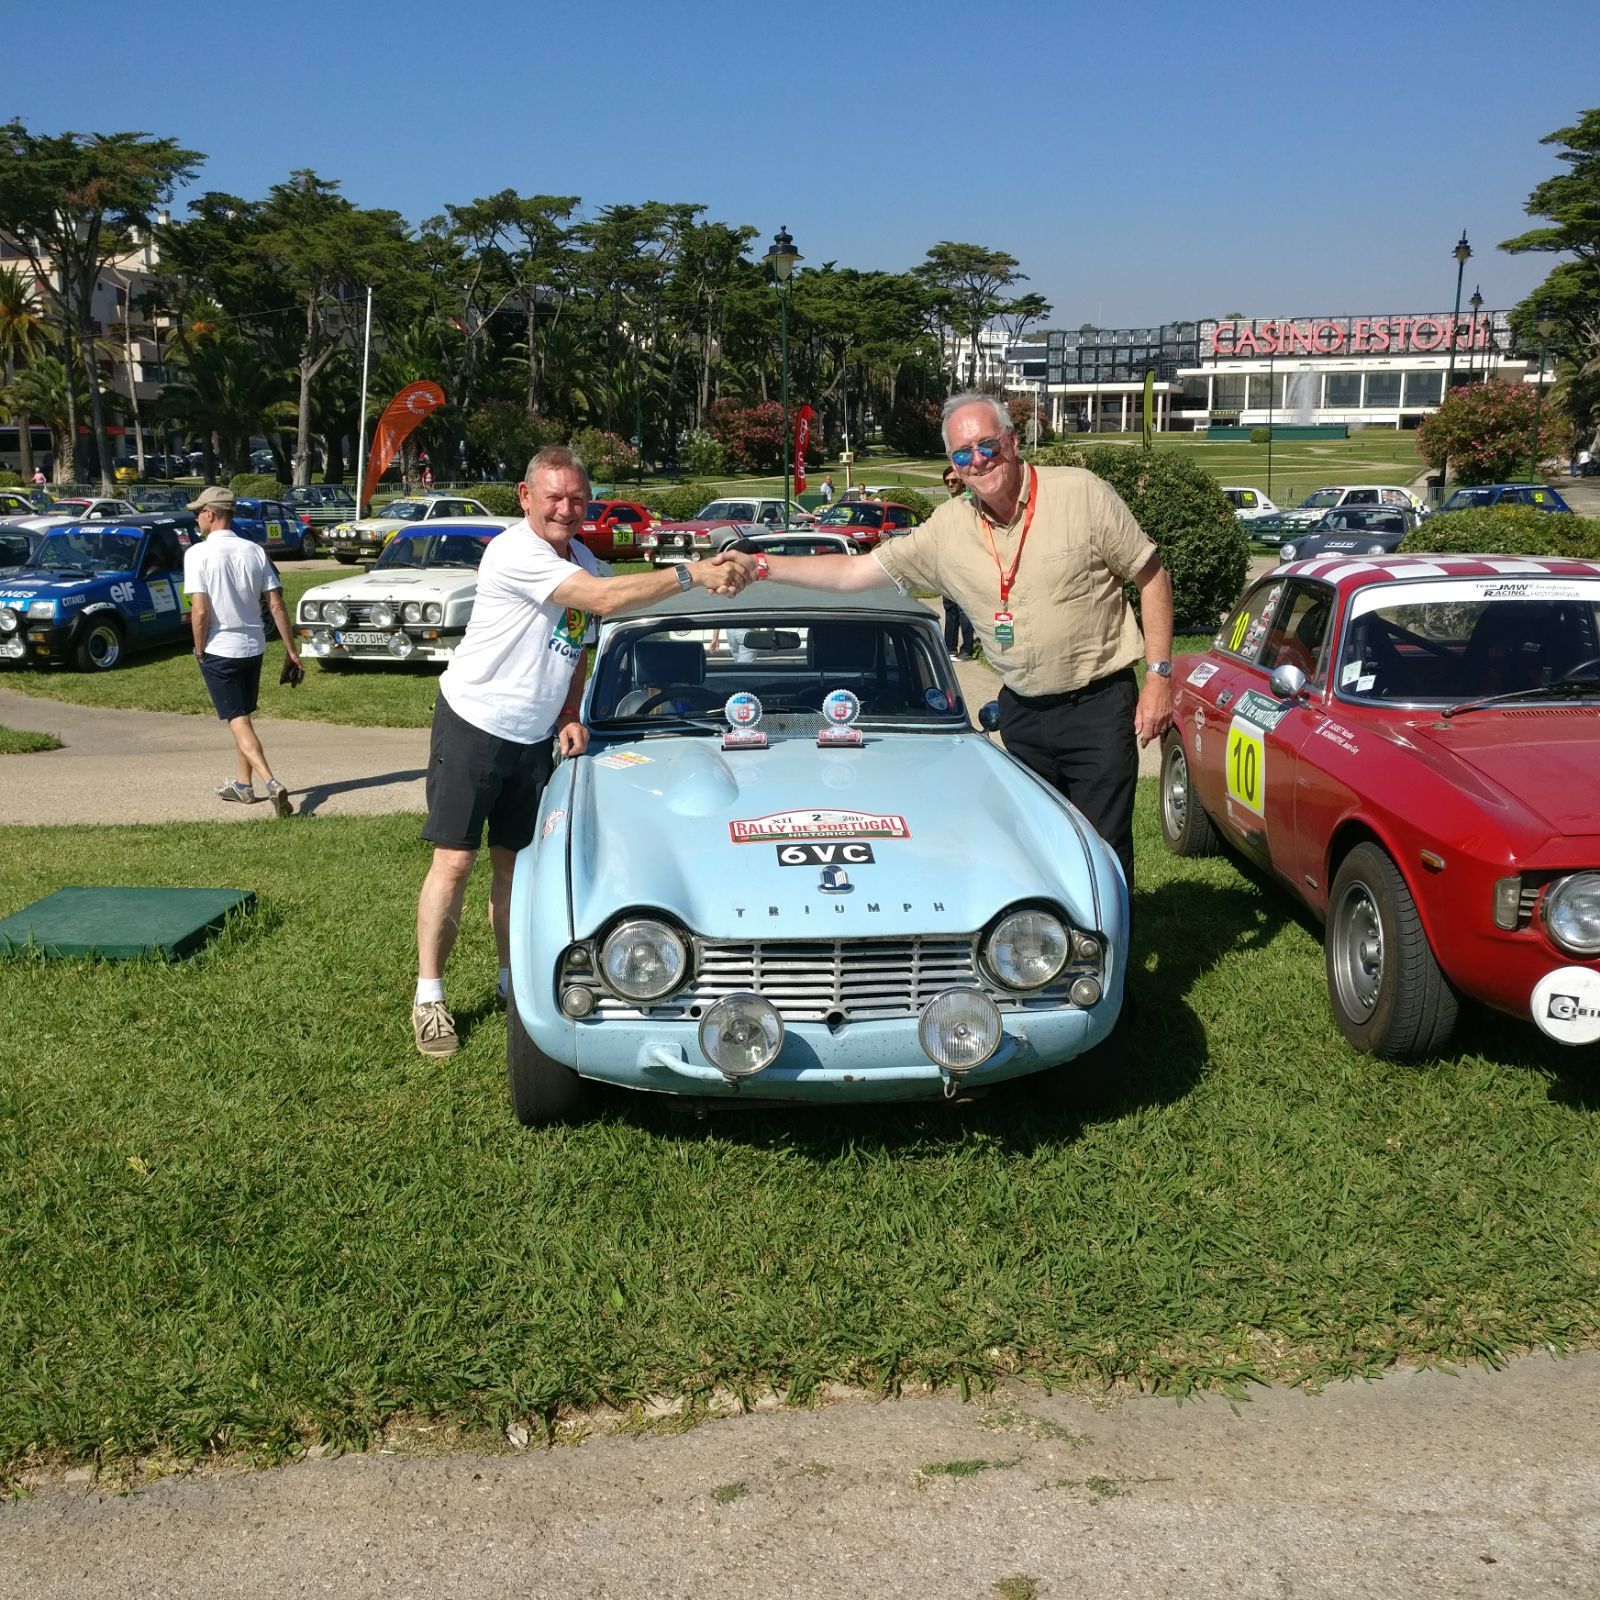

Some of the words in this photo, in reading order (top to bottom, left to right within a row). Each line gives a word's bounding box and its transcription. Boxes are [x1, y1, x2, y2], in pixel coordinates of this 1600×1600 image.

[1214, 322, 1344, 353] CASINO
[270, 526, 279, 537] 66
[617, 531, 629, 542] 99
[110, 582, 135, 603] elf
[62, 594, 86, 608] CITANES
[342, 632, 367, 645] 2520
[370, 633, 389, 645] DHS
[1228, 610, 1250, 652] 10
[1233, 737, 1256, 802] 10
[812, 814, 822, 822] 2
[736, 822, 786, 836] RALLY
[816, 817, 902, 832] PORTUGAL
[788, 830, 856, 838] HISTORICO
[781, 845, 868, 864] 6VC
[736, 902, 945, 918] TRIUMPH
